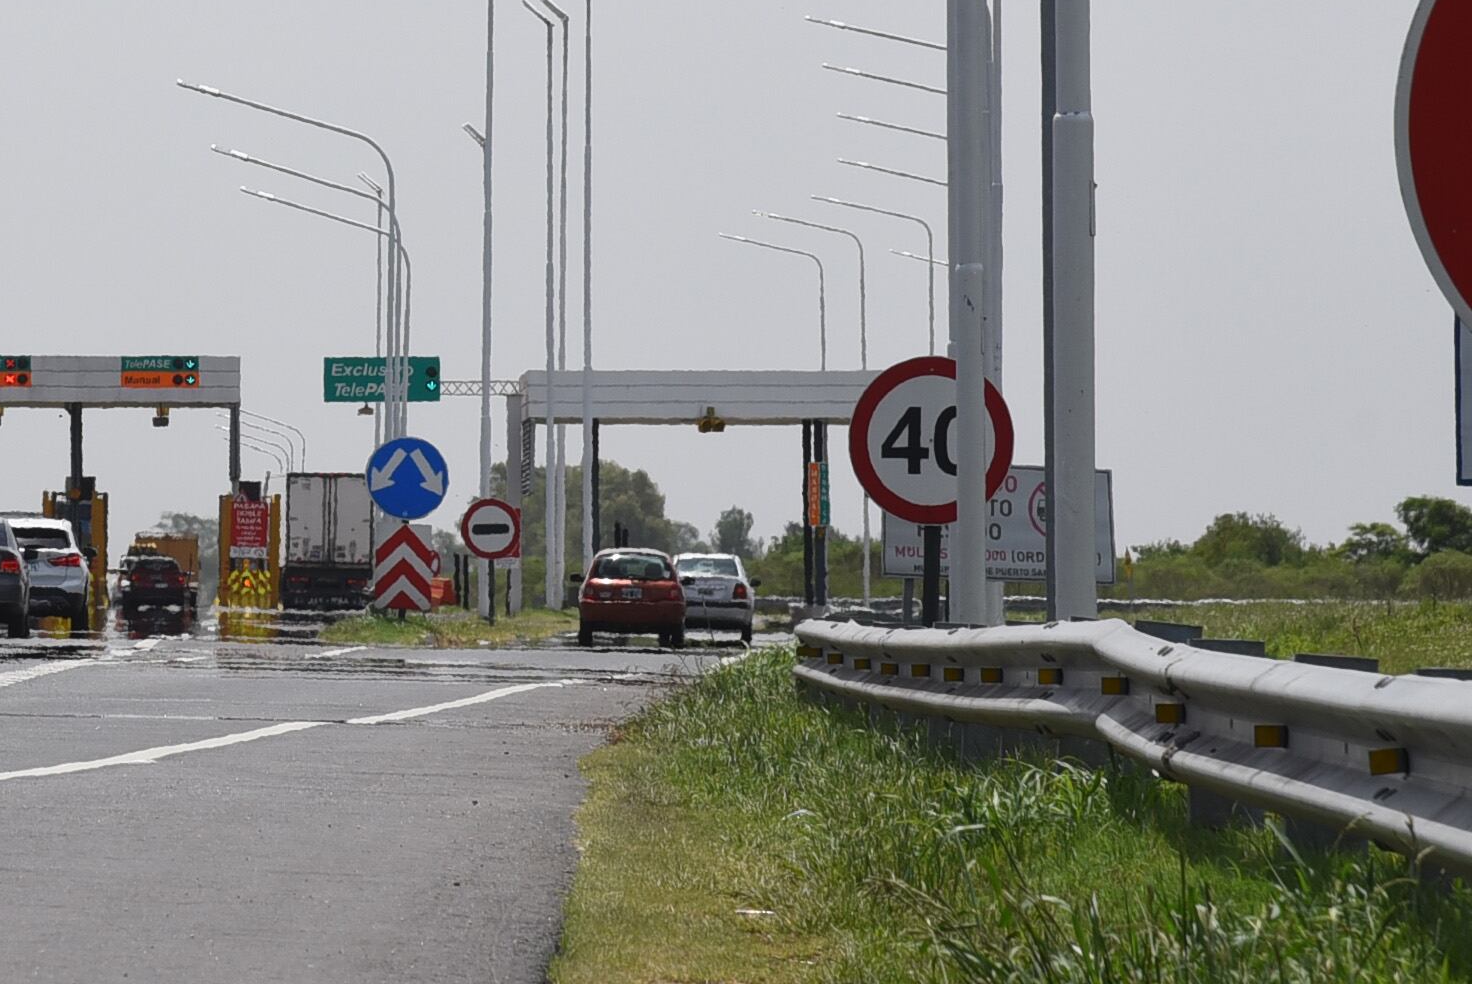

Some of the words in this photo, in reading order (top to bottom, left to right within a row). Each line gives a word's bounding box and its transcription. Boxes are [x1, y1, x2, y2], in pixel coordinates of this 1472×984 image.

[125, 359, 170, 369] TelePASE
[331, 363, 414, 376] Excluso
[124, 375, 160, 385] Manual
[334, 382, 410, 397] TelePA
[895, 546, 949, 559] MULS
[995, 567, 1029, 576] PUERTO
